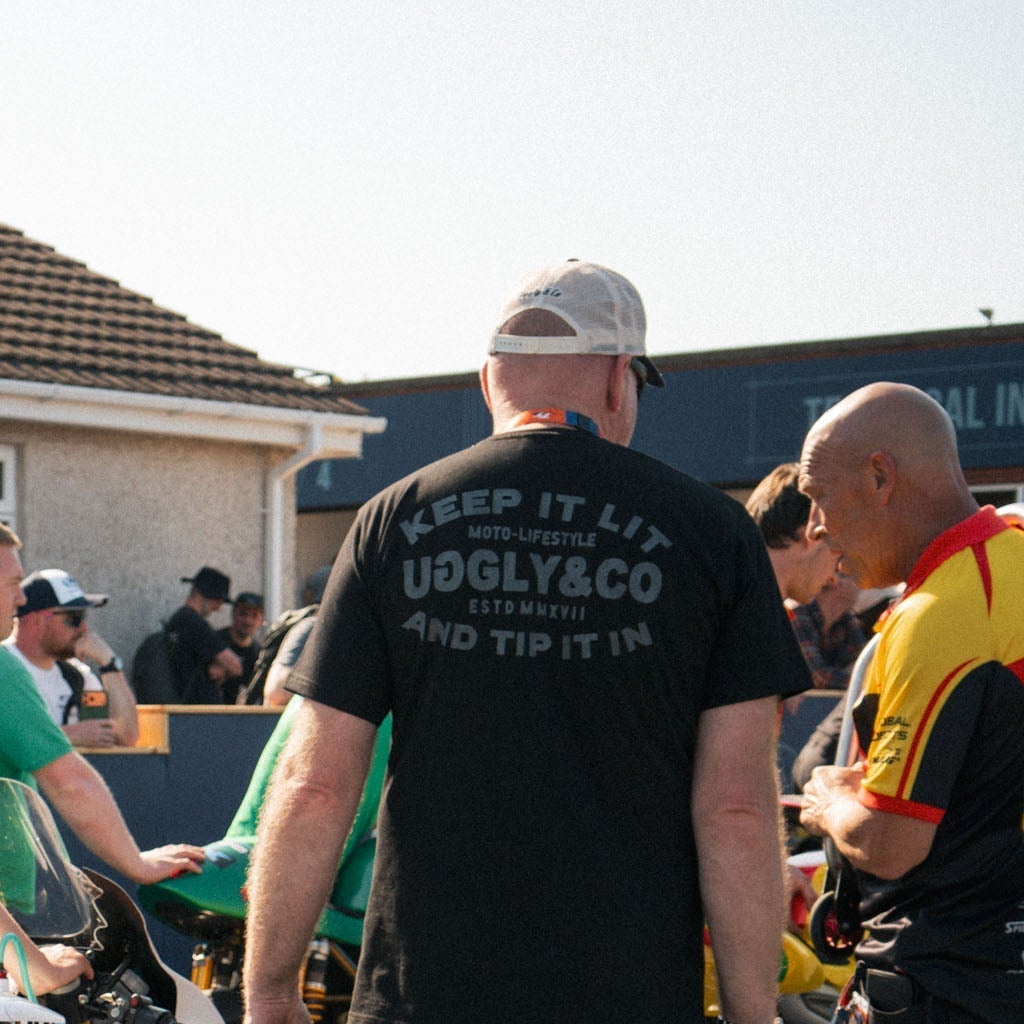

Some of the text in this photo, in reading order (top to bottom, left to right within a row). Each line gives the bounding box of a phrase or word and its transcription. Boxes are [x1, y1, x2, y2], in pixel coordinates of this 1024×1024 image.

[399, 488, 672, 553] KEEP IT LIT
[468, 525, 597, 548] MOTO-LIFESTYLE
[403, 550, 663, 604] UGGLY&CO
[469, 600, 513, 615] ESTD
[402, 610, 653, 660] AND TIP IT IN
